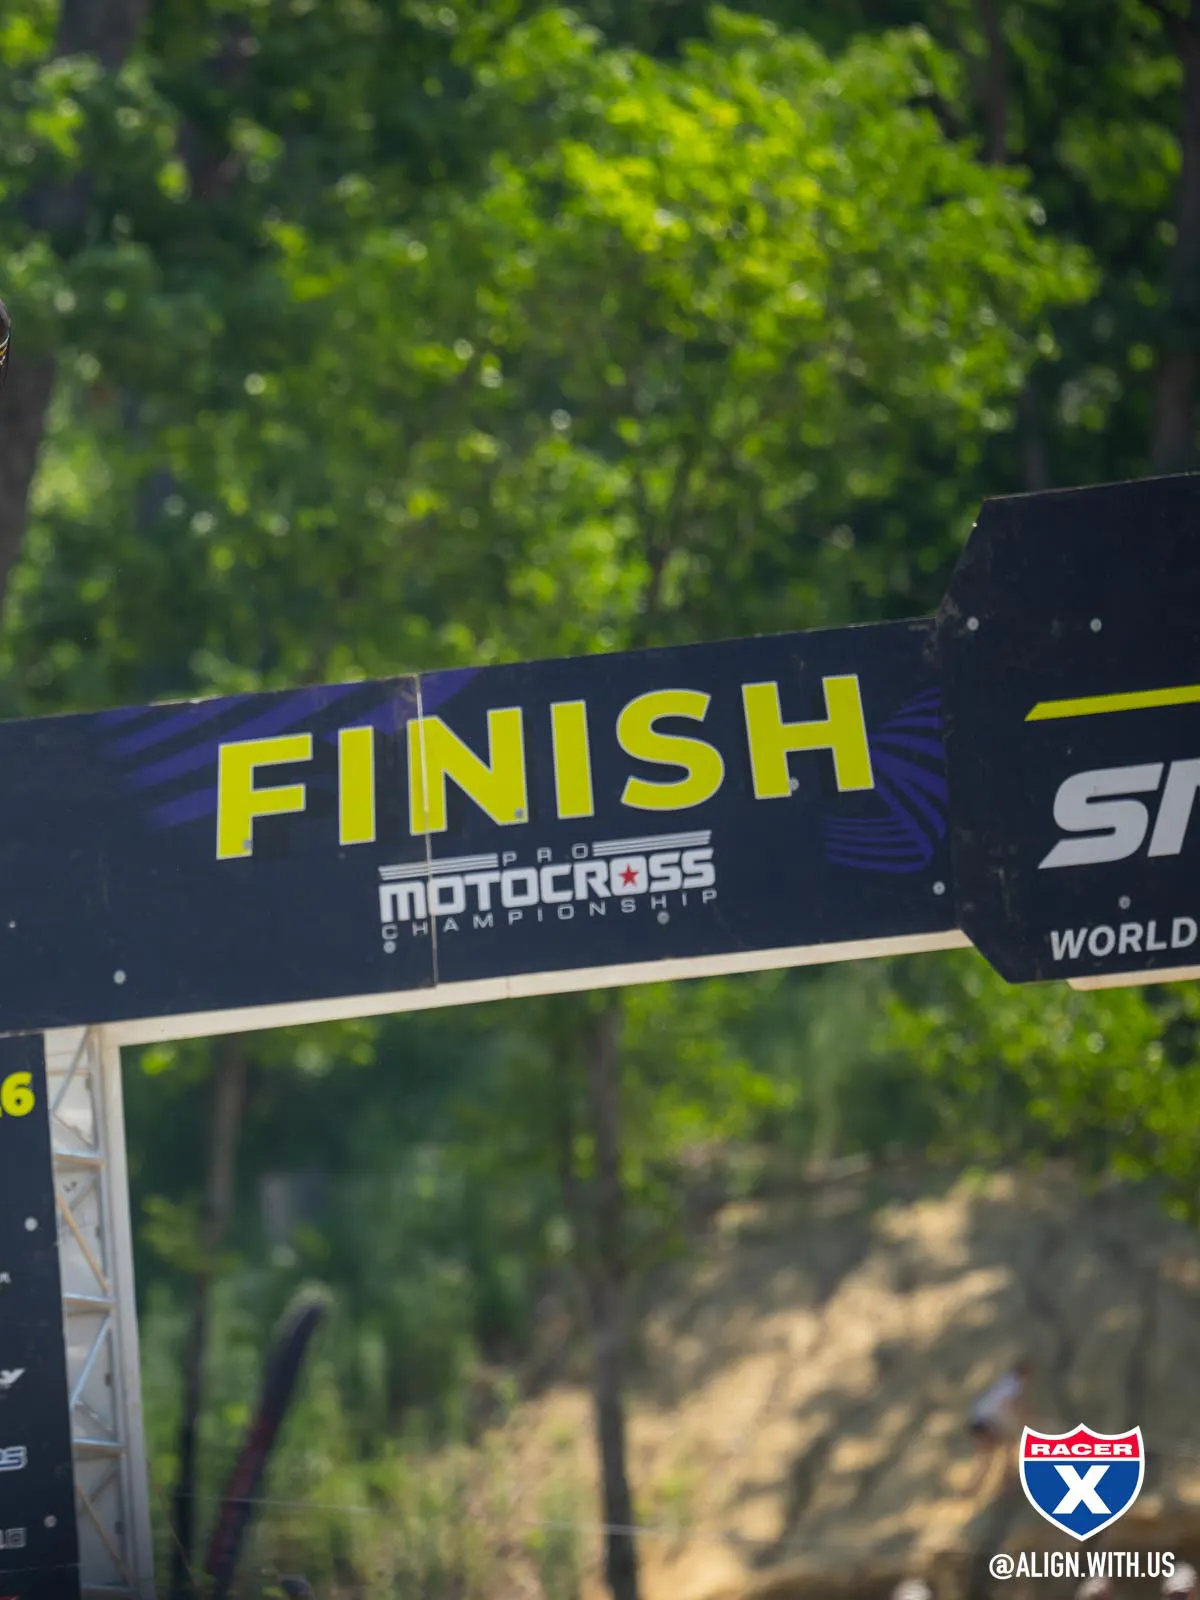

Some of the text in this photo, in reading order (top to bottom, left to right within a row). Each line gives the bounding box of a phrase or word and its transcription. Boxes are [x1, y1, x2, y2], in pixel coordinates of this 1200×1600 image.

[217, 674, 875, 859] FINISH
[502, 843, 589, 867] PRO
[378, 847, 716, 923] MOTOCROSS
[382, 888, 717, 940] CHAMPIONSHIP
[1050, 916, 1198, 961] WORLD
